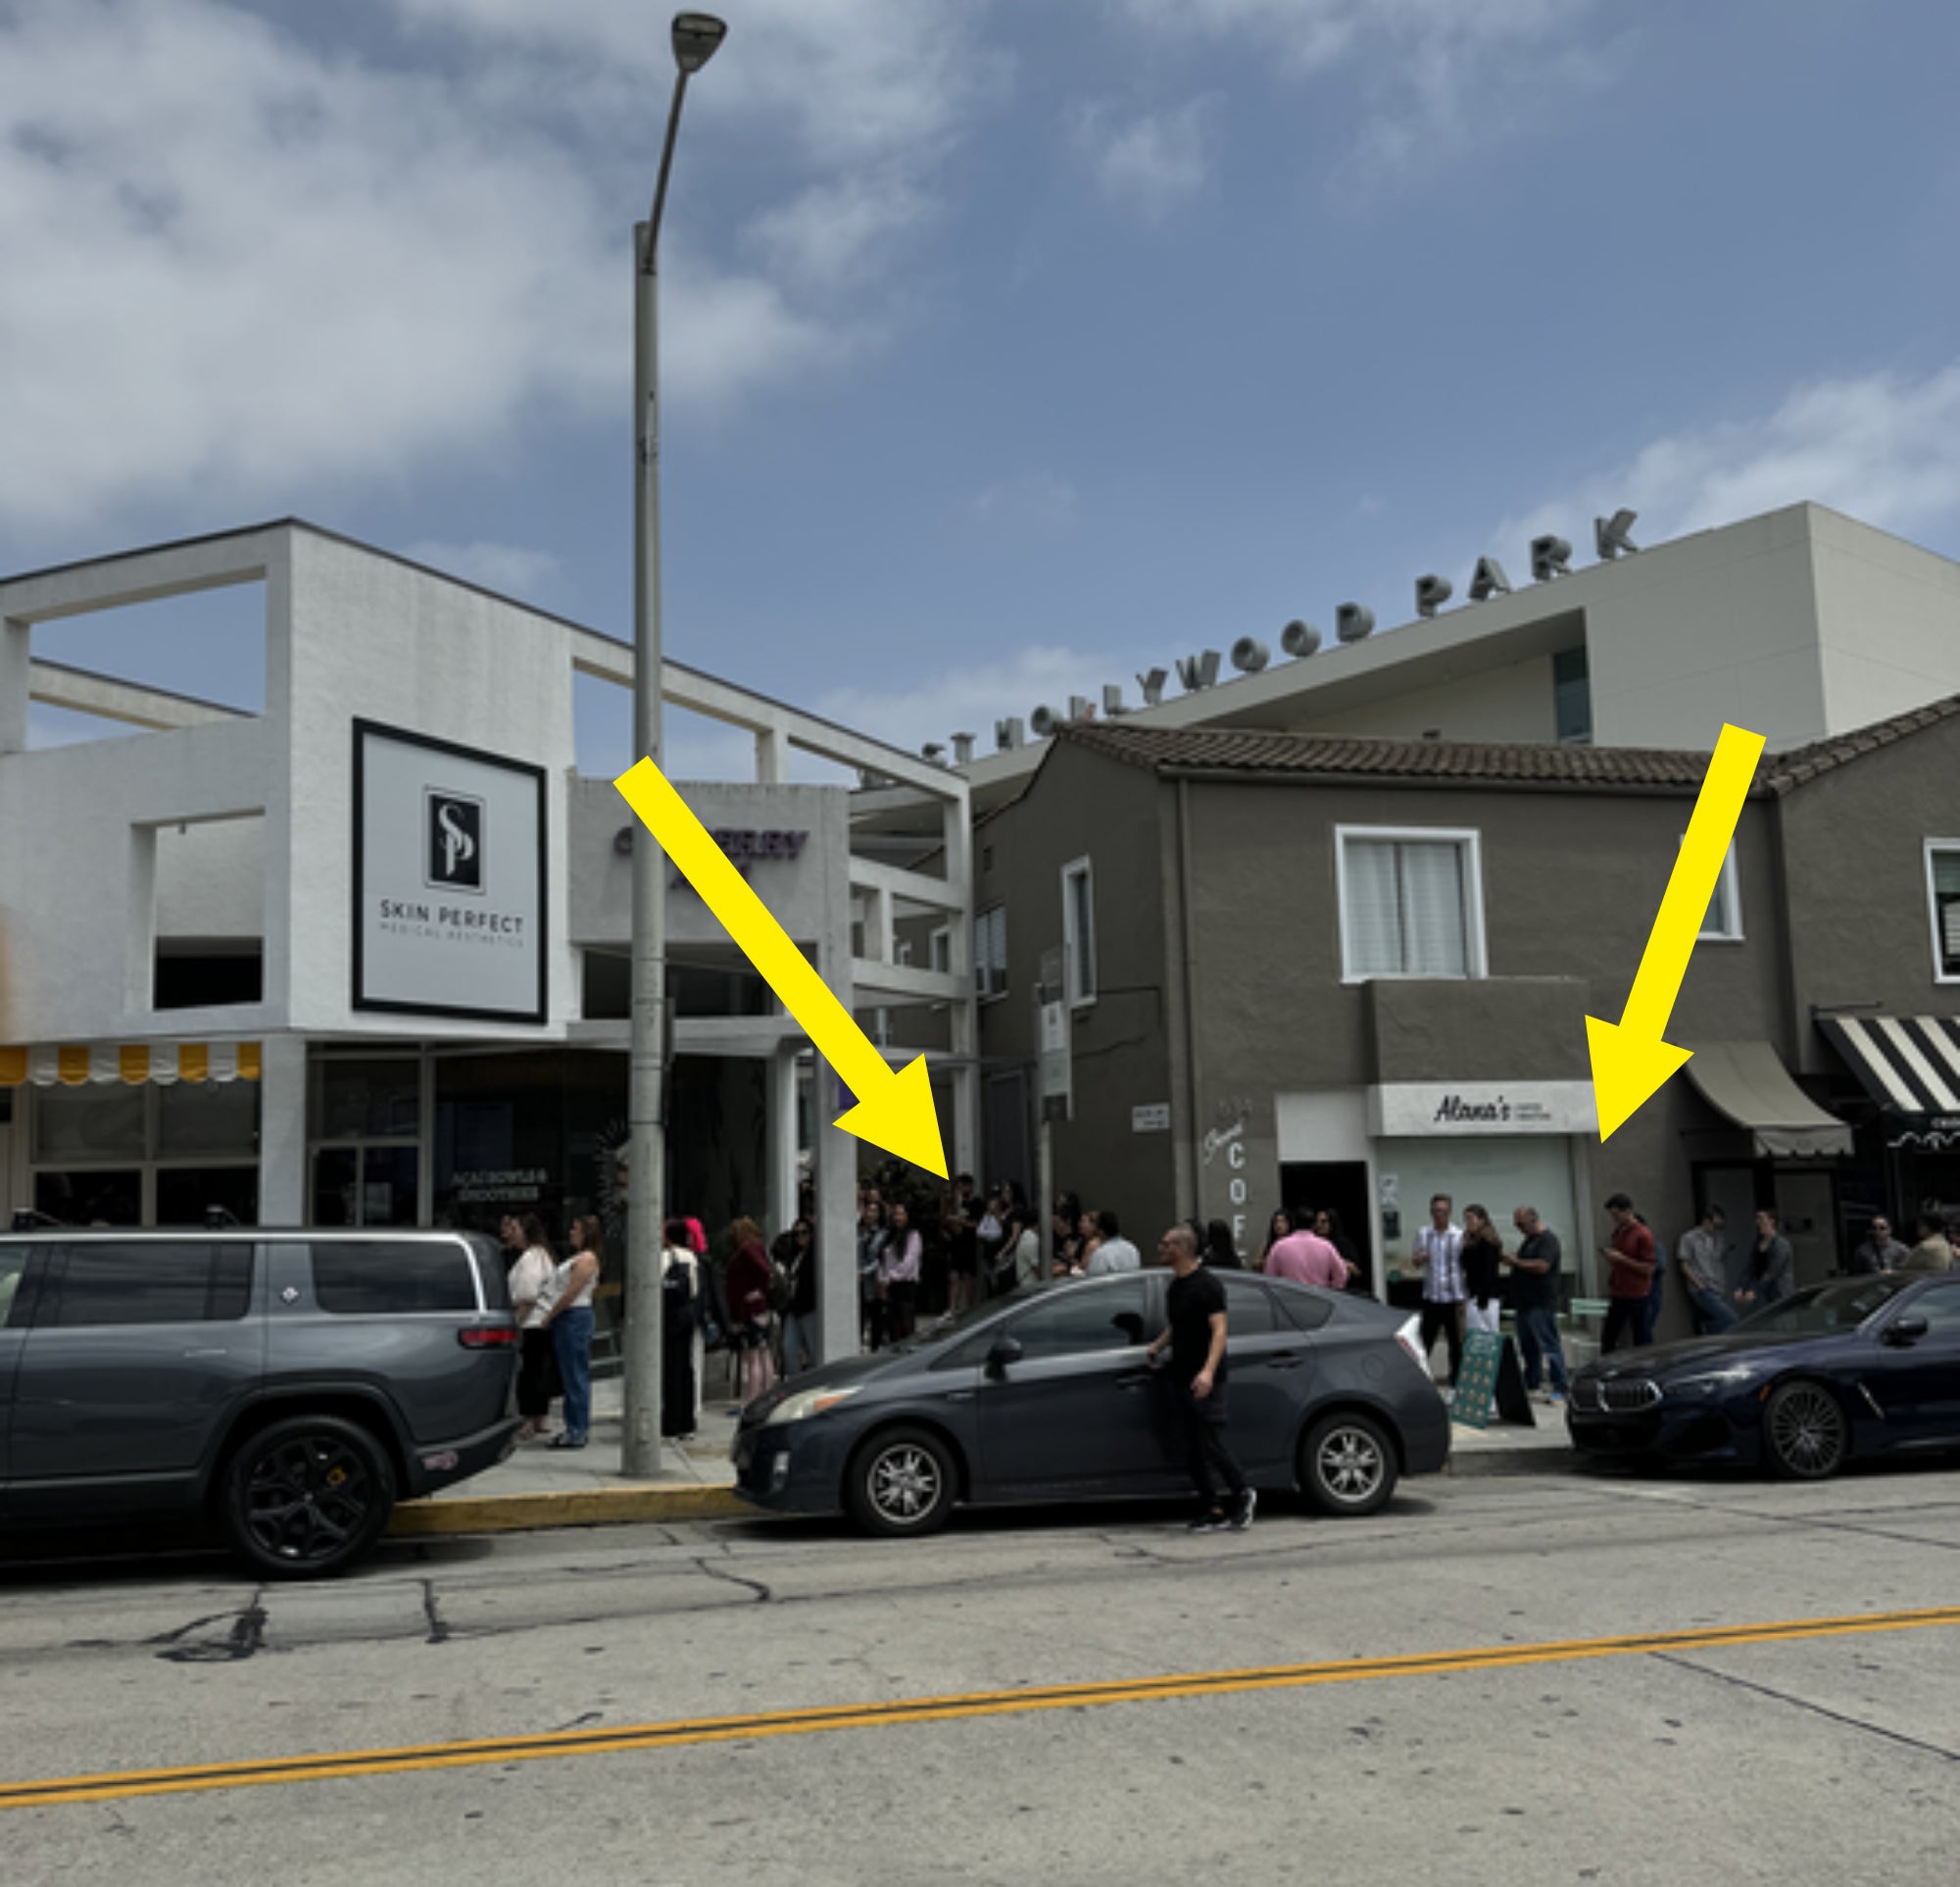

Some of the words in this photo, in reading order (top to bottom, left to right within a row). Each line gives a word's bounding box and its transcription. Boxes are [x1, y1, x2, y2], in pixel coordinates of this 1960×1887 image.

[1414, 508, 1639, 619] PARK
[380, 899, 429, 922] SKIN
[438, 906, 524, 933] PERFECT
[1434, 1095, 1511, 1121] Alana's
